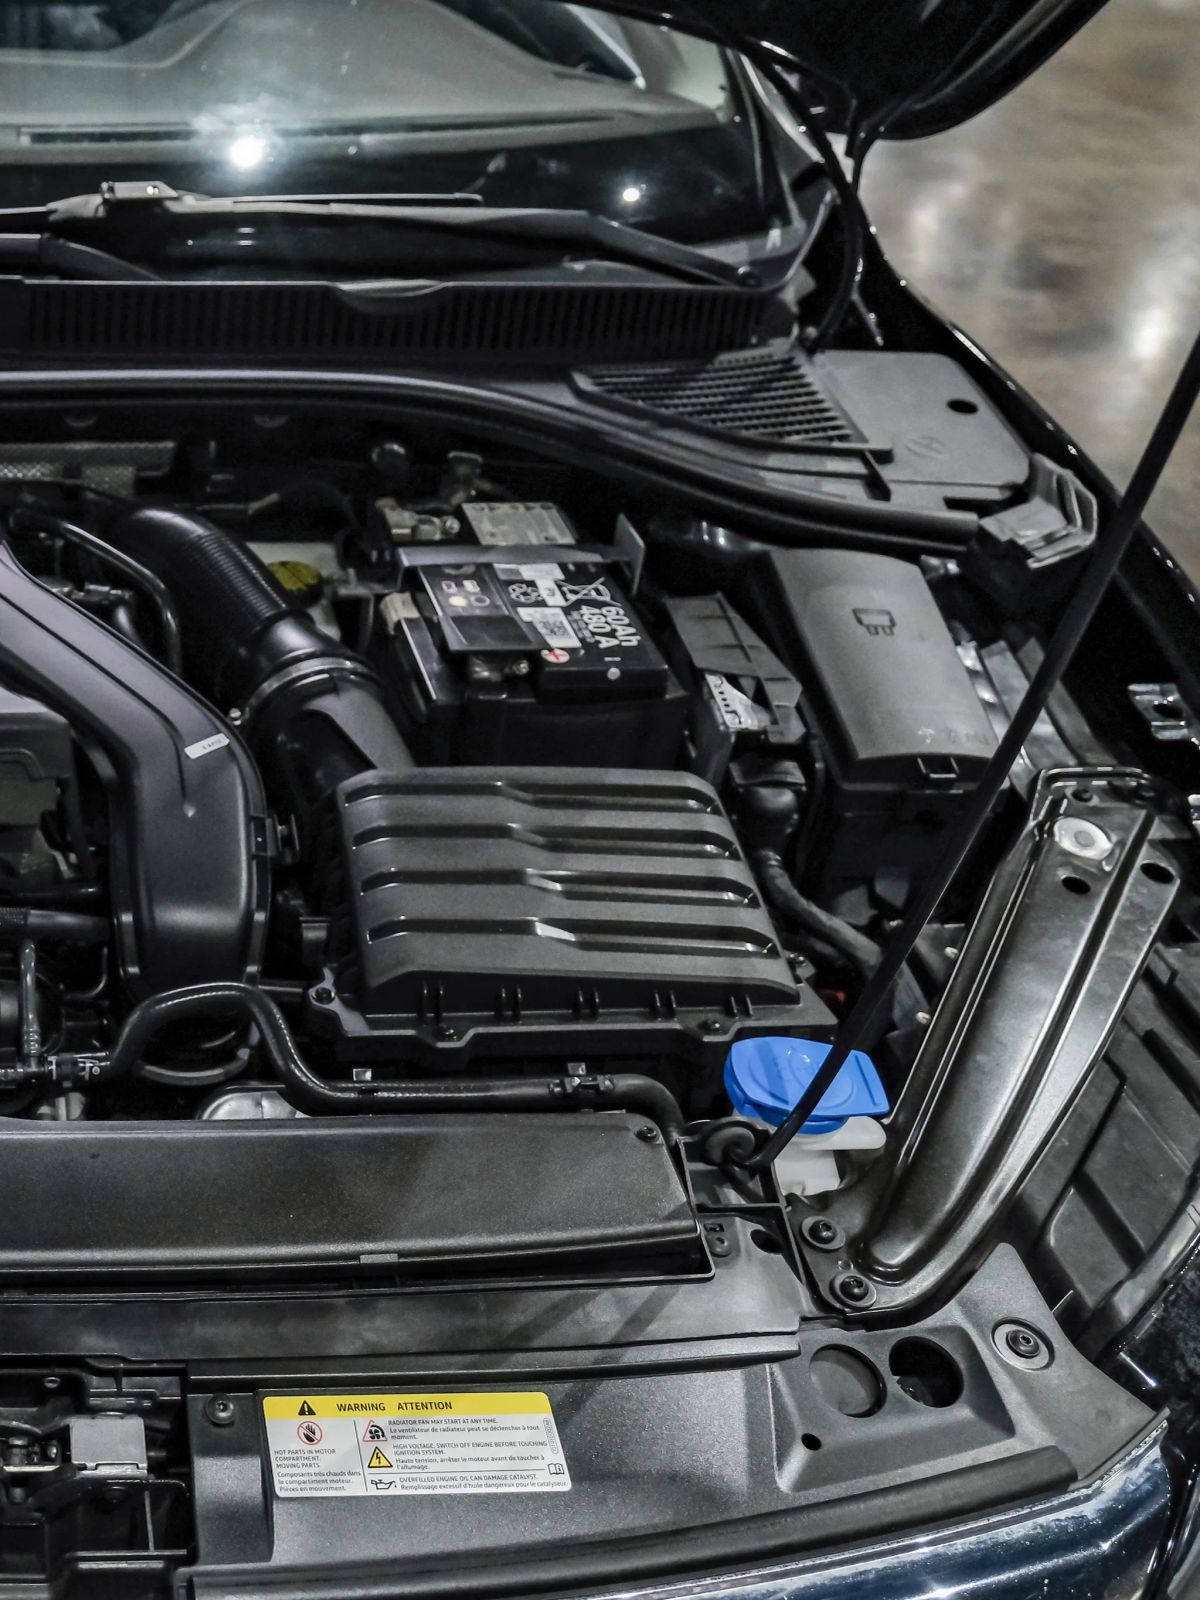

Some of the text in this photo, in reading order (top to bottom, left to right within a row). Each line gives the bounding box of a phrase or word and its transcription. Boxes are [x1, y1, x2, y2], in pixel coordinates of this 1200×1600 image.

[579, 605, 610, 633] 480
[597, 637, 620, 649] A
[600, 606, 641, 647] 60Ah
[337, 1402, 453, 1412] WARNING ATTENTION
